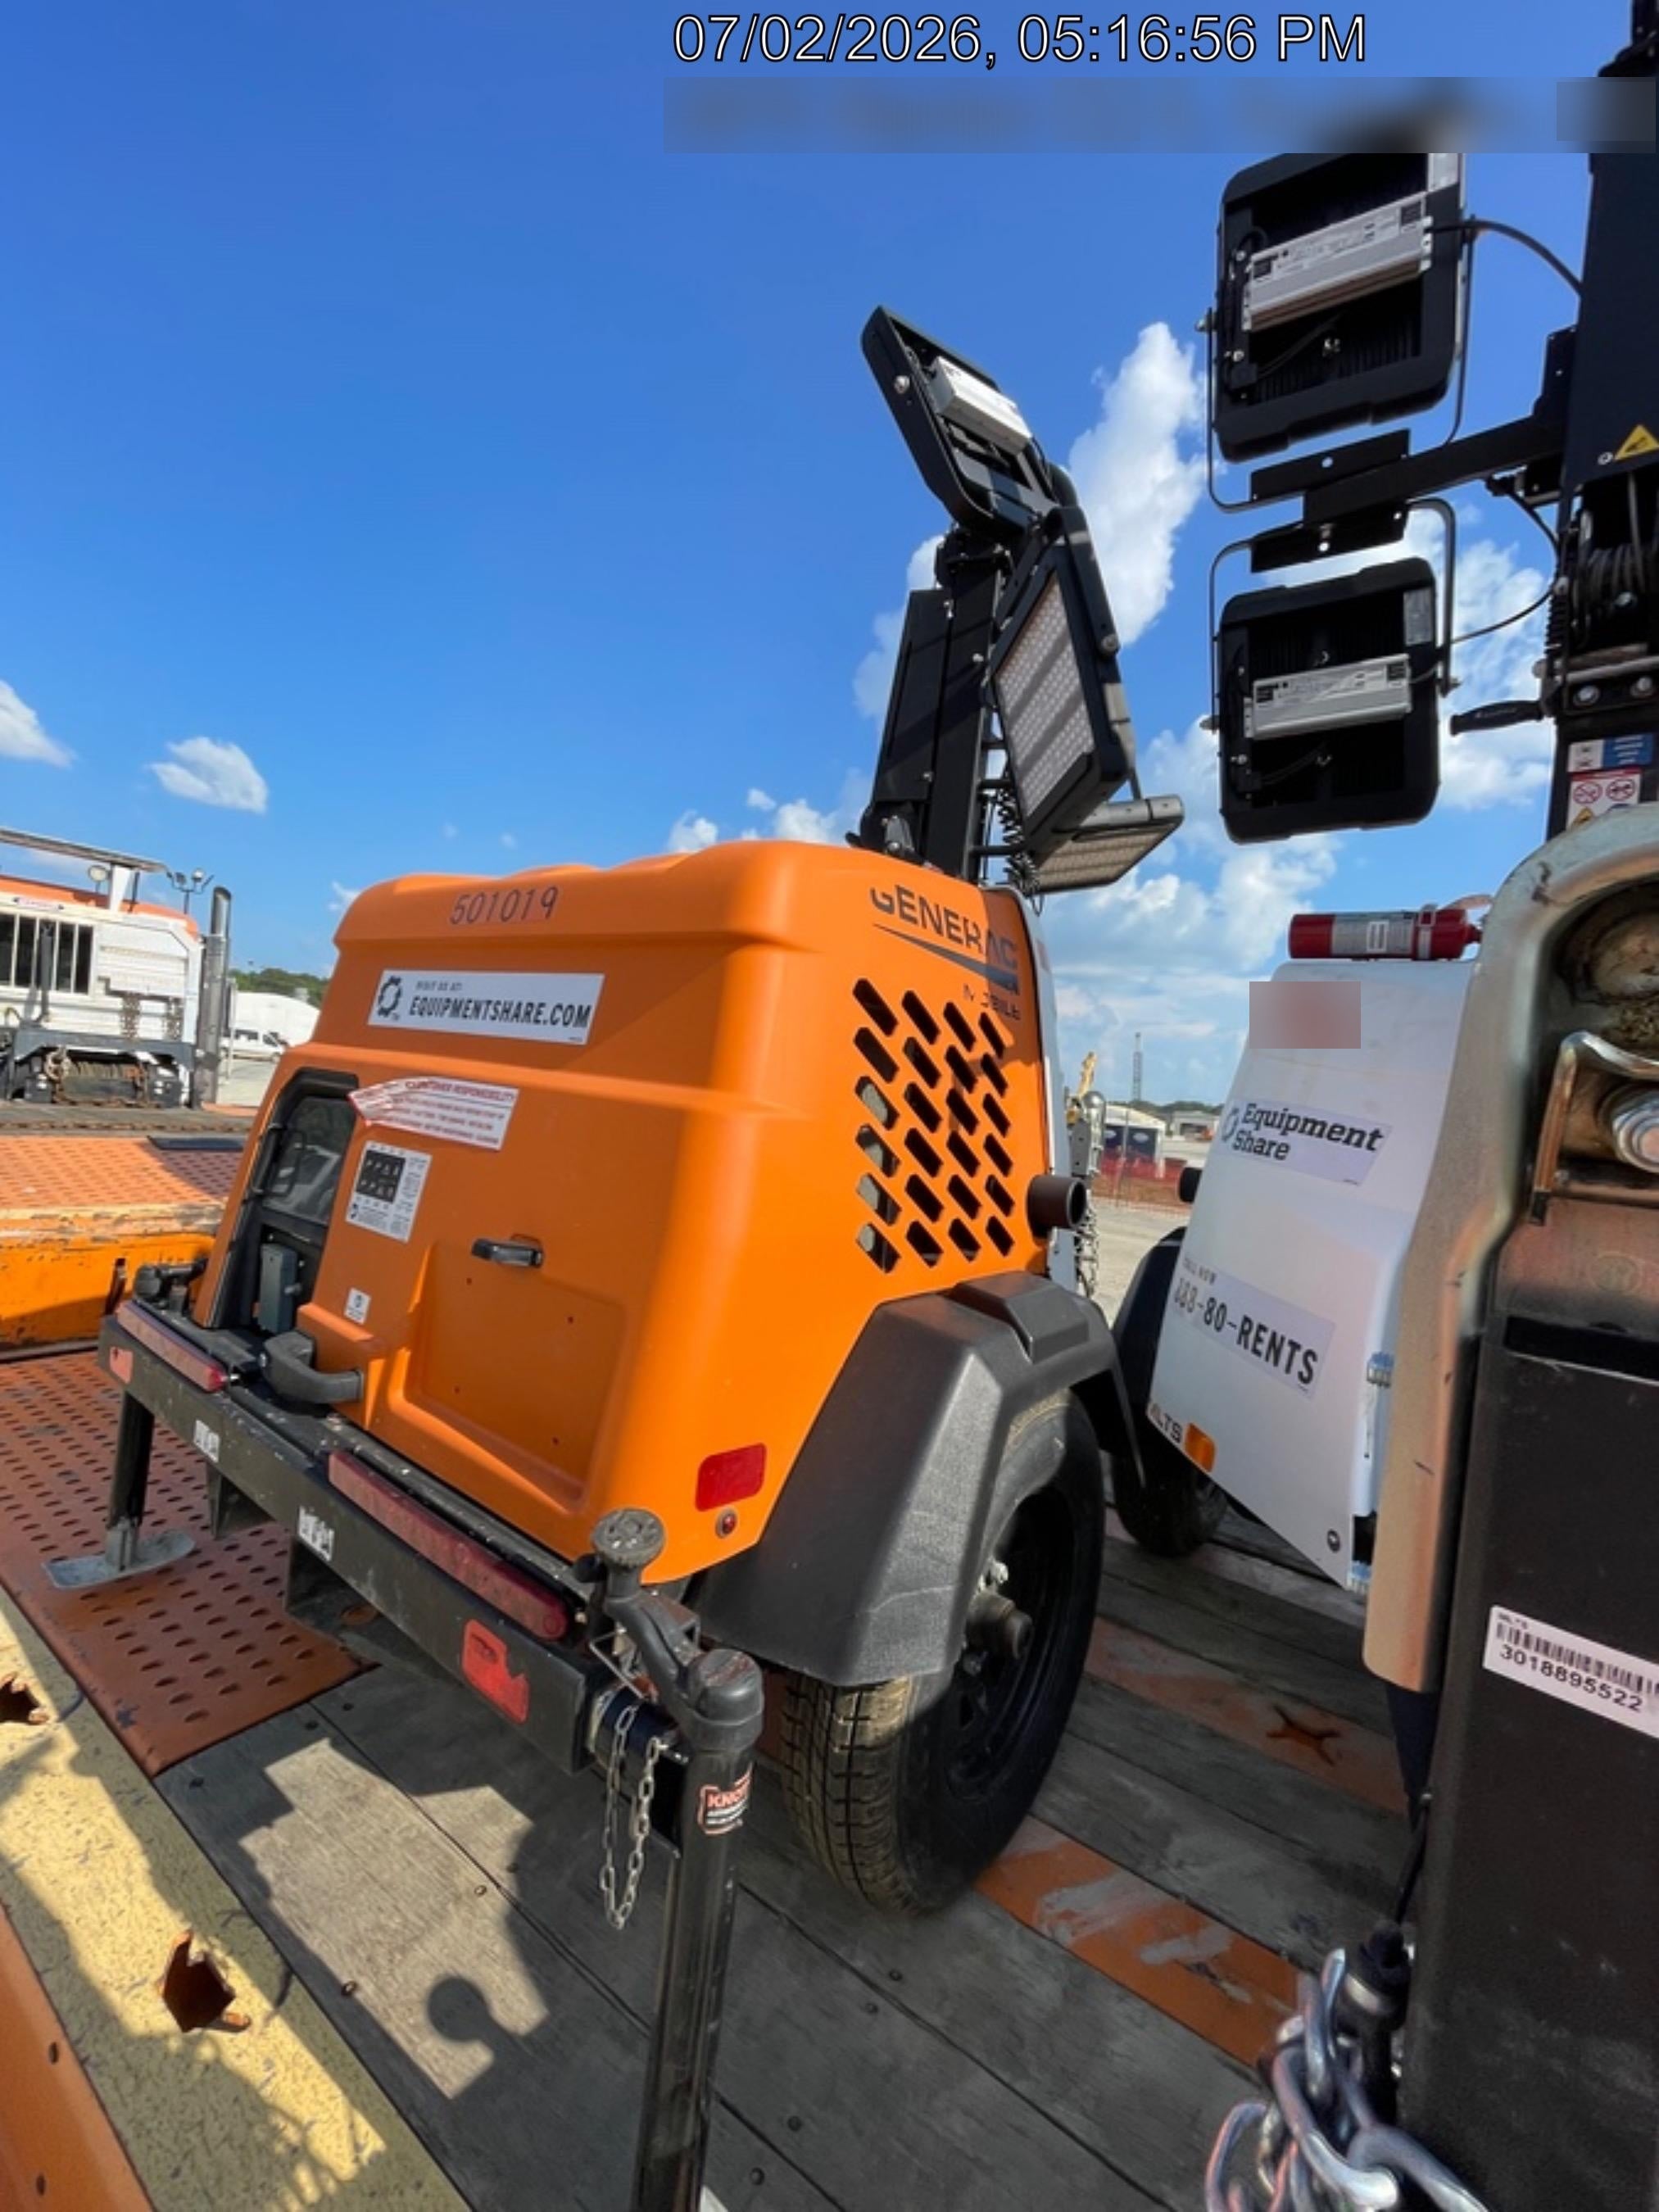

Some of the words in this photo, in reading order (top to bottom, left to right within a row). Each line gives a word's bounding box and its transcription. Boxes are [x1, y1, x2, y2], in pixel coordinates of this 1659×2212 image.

[449, 886, 560, 926] 501019
[409, 995, 592, 1028] EQUIPMENTSHARE.COM
[1231, 1129, 1290, 1161] Share
[1241, 1103, 1385, 1152] Equipment
[1499, 1643, 1643, 1713] 3018895522
